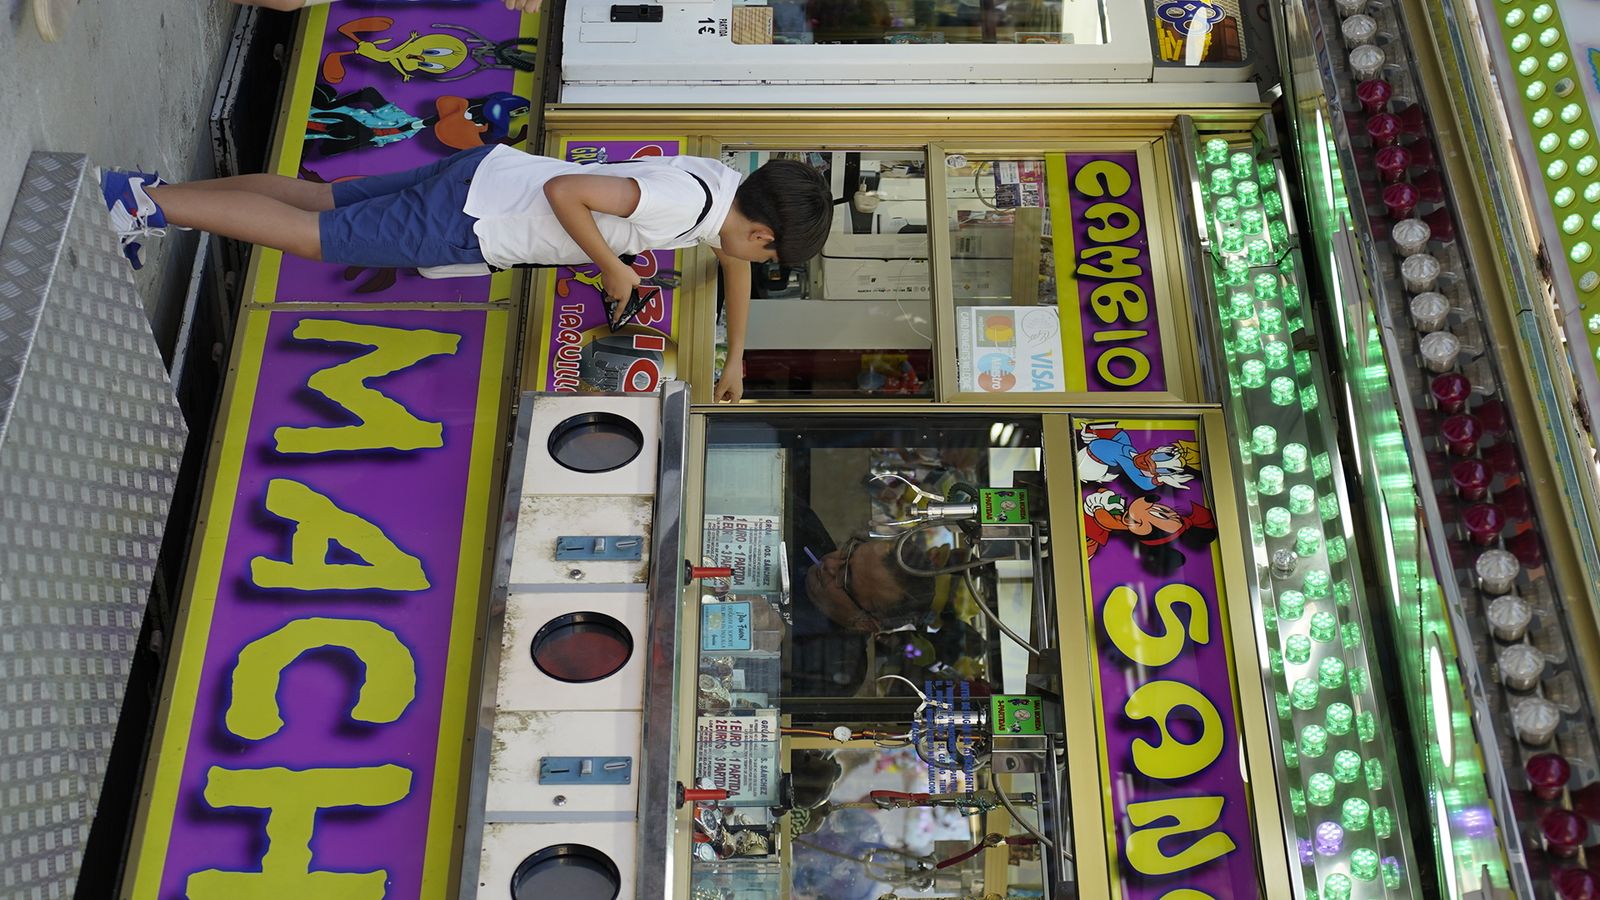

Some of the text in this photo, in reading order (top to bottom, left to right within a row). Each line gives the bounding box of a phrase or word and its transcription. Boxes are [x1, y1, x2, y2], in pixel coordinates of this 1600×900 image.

[698, 18, 715, 35] 1€
[719, 18, 728, 37] PARTIDA
[1076, 160, 1150, 386] CAMBIO
[1031, 352, 1055, 391] VISA
[735, 523, 747, 542] EURO
[733, 556, 746, 586] PARTIDA
[730, 726, 742, 748] EURO
[1102, 583, 1236, 900] SAN
[728, 764, 741, 796] PARTIDA
[760, 766, 770, 796] SÁNCHEZ
